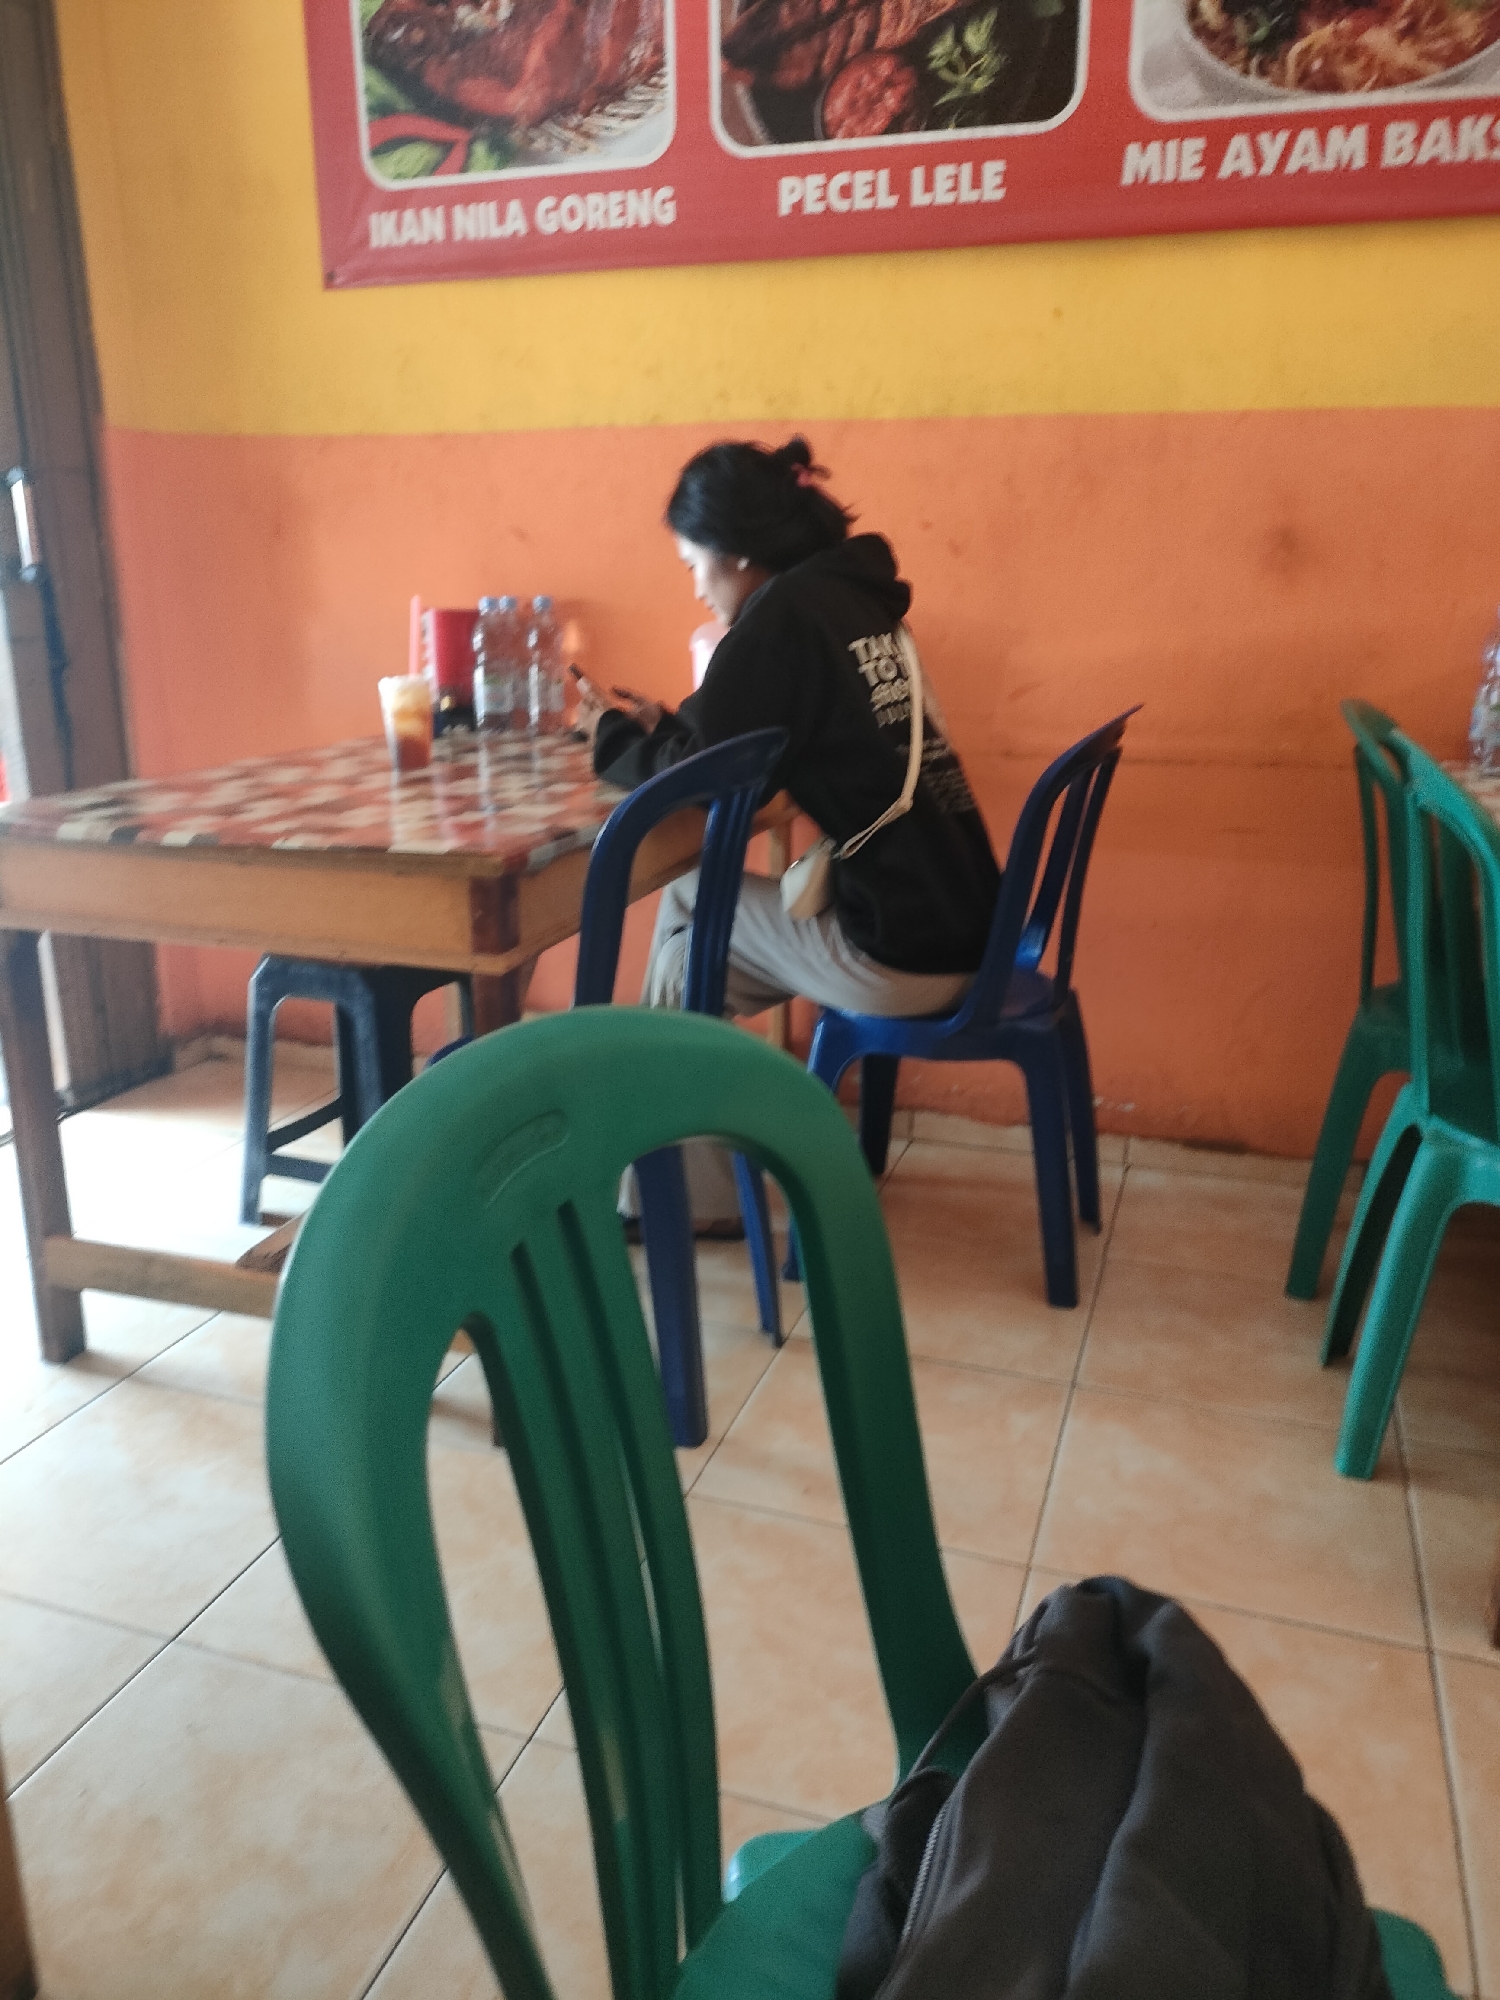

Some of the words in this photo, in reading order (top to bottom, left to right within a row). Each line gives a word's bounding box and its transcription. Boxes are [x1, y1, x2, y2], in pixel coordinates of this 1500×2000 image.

[1121, 138, 1206, 185] MIE
[1217, 125, 1368, 179] AYAM
[368, 206, 445, 248] IKAN
[453, 198, 527, 241] NILA
[535, 186, 676, 235] GORENG
[778, 168, 899, 216] PECEL
[910, 160, 1006, 207] LELE
